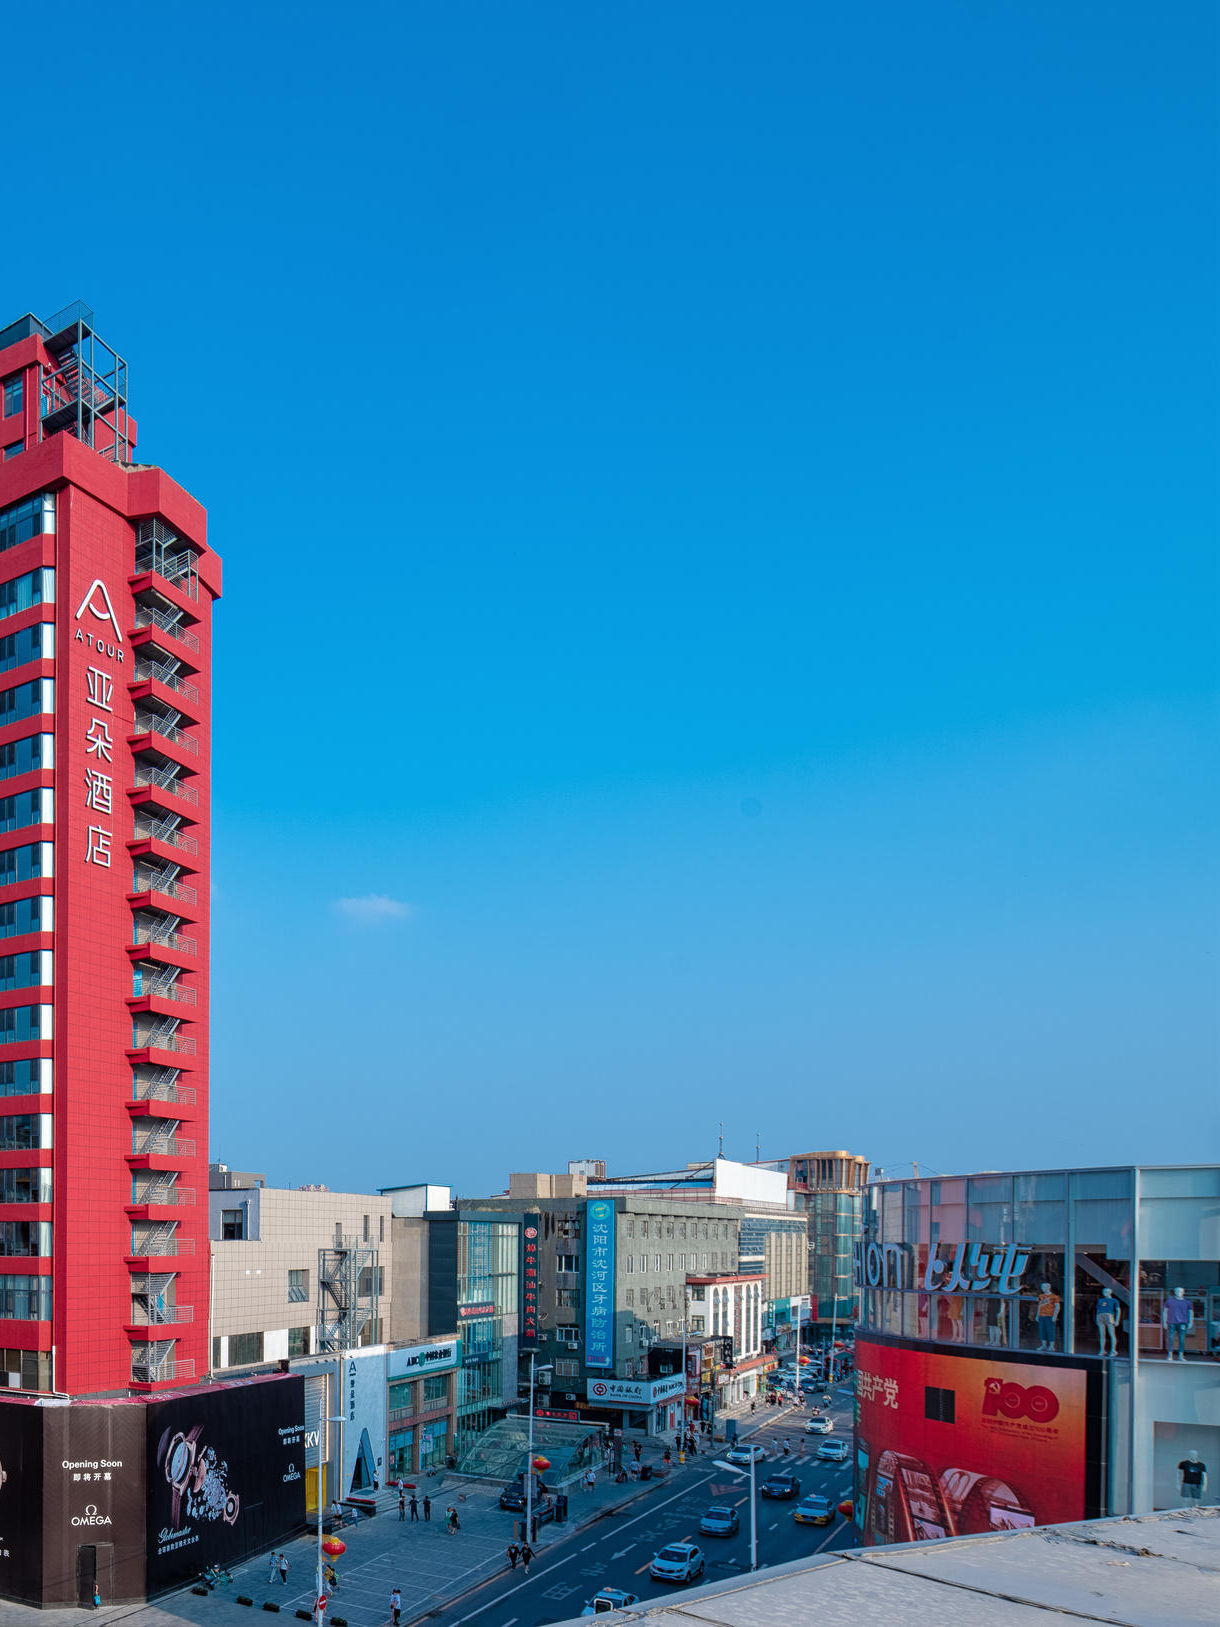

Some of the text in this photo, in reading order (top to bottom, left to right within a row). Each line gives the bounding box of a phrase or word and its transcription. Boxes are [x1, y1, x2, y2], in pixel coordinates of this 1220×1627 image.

[75, 628, 125, 663] ATOUR
[85, 665, 113, 868] 亚朵酒店
[591, 1223, 608, 1353] 沈阳市沈河区牙病防治所
[62, 1459, 123, 1470] Opening Soon
[73, 1472, 112, 1481] 即将开幕
[282, 1471, 301, 1482] OMEGA
[71, 1515, 112, 1526] OMEGA
